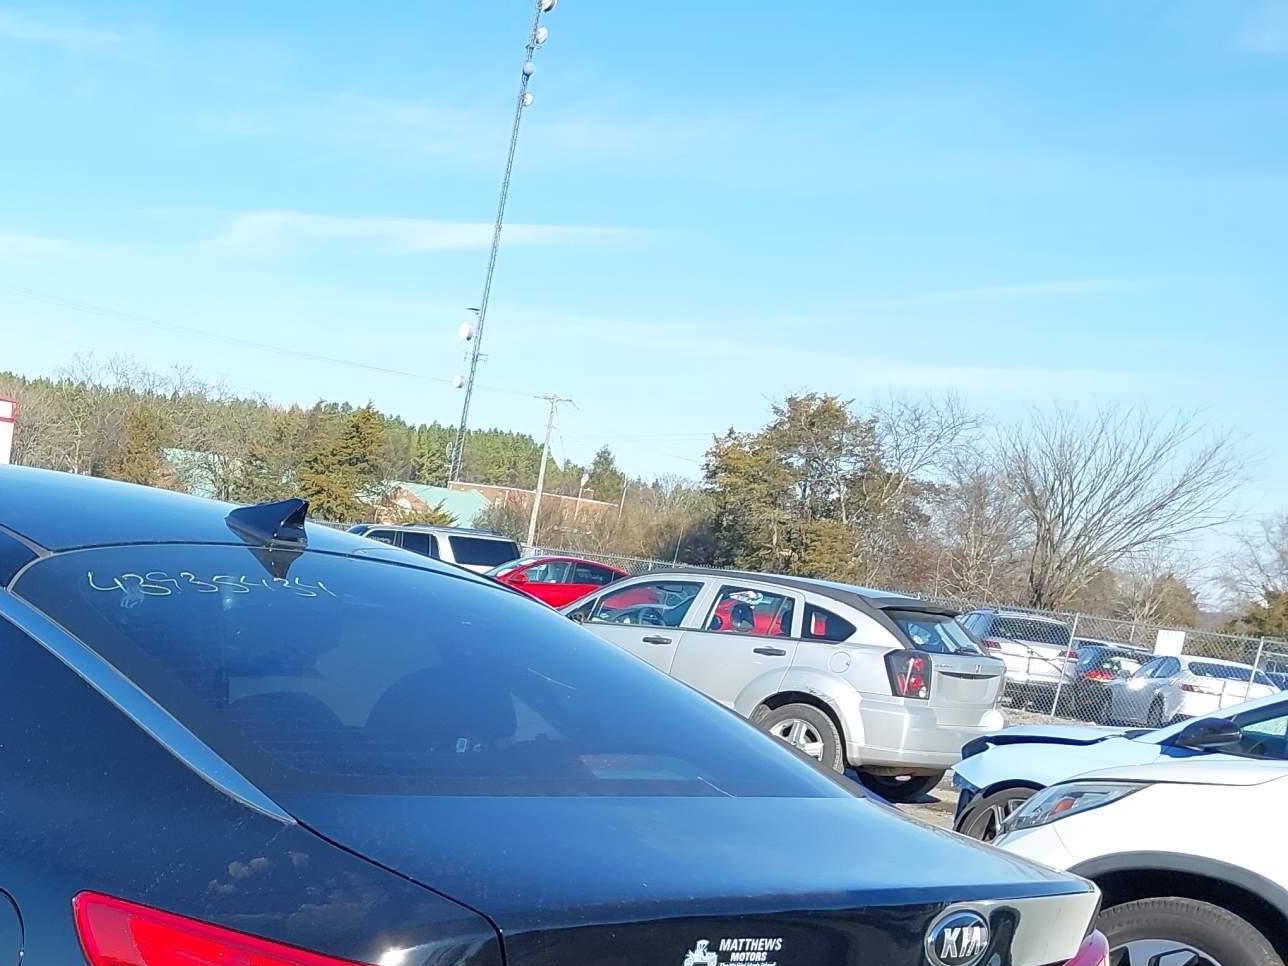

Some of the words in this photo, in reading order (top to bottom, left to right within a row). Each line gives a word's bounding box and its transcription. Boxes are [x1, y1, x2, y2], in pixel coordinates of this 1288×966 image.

[719, 938, 783, 951] MATTHEWS
[940, 926, 982, 959] KIA
[730, 951, 768, 962] MOTORS
